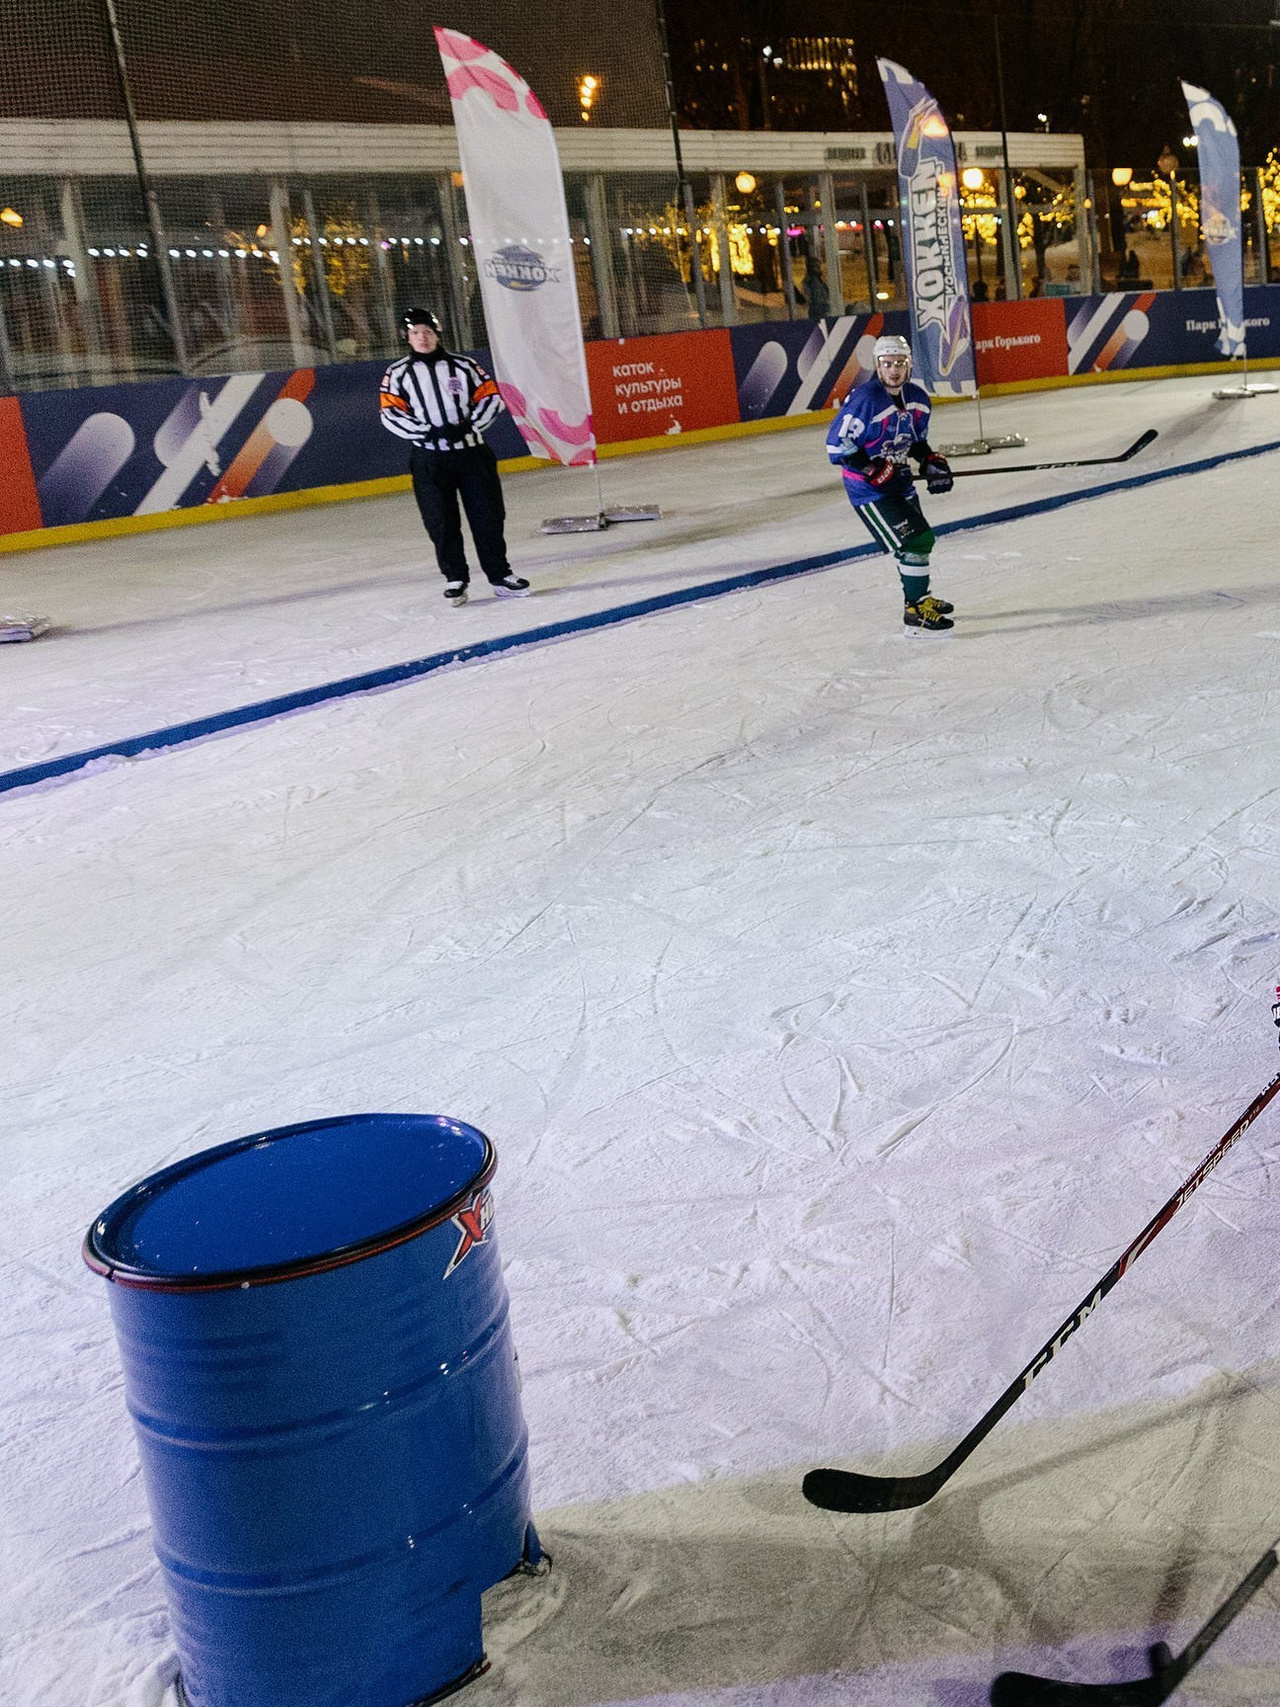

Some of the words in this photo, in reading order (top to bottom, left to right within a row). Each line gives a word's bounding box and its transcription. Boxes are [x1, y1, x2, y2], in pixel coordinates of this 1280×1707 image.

[1185, 319, 1217, 334] Парк
[974, 338, 995, 353] арк
[612, 362, 655, 377] каток
[615, 378, 682, 398] культуры
[618, 402, 628, 414] и
[630, 394, 683, 413] отдыха
[1172, 1119, 1250, 1215] JETSPEED
[1022, 1288, 1102, 1388] CCM
